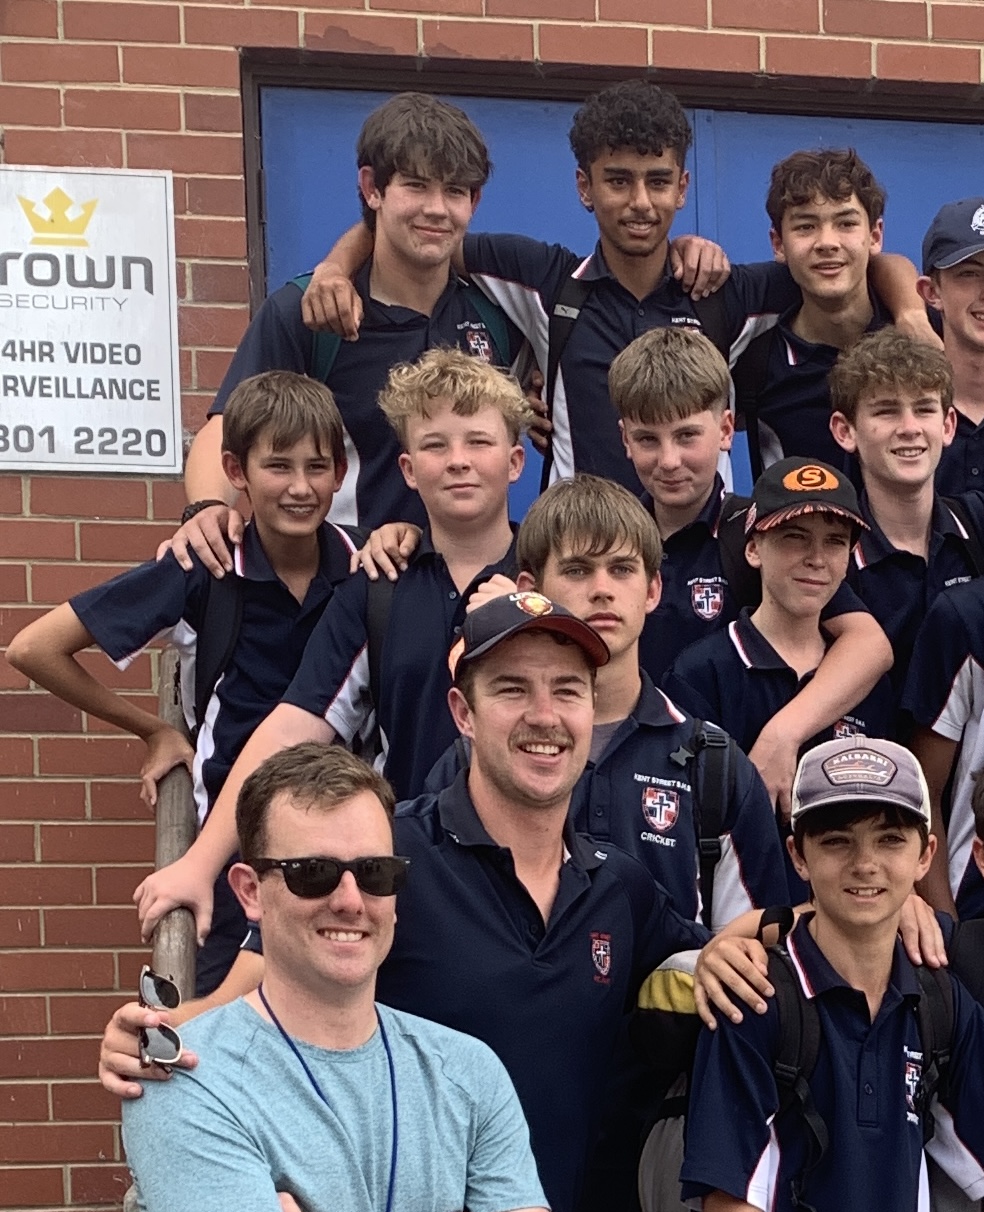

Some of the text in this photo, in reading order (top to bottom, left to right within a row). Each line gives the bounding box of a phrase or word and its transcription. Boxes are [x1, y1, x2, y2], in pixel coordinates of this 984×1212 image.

[0, 251, 154, 296] rown
[0, 293, 129, 311] SECURITY
[1, 339, 142, 366] 4HR VIDEO
[2, 374, 161, 402] RVEILLANCE
[74, 426, 167, 457] 2220
[801, 468, 822, 486] S
[651, 776, 677, 787] STREET
[640, 831, 677, 848] CRICKET
